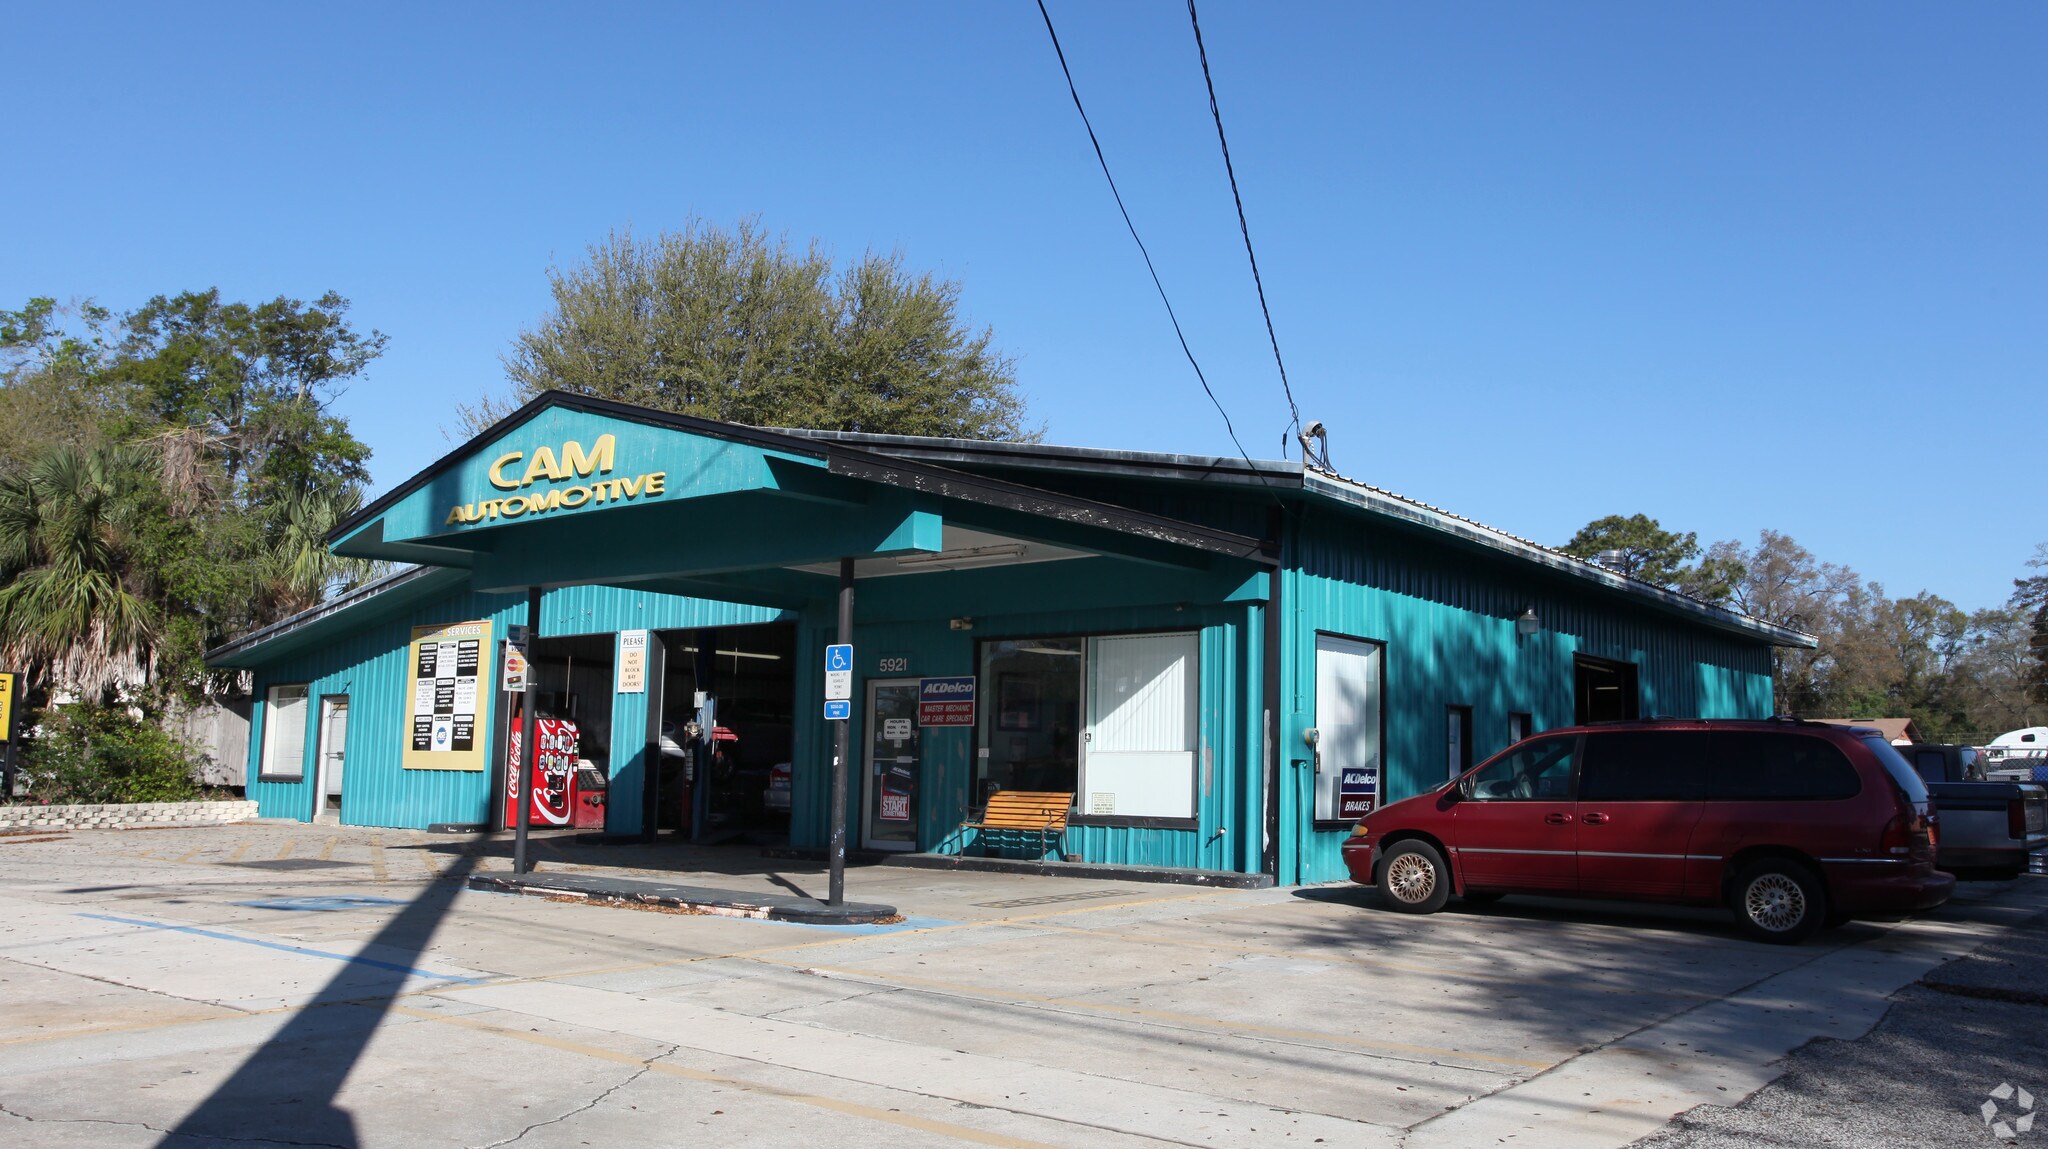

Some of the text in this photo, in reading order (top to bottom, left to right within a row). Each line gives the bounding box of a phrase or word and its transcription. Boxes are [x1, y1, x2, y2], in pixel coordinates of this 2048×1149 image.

[488, 433, 616, 490] CAM
[445, 471, 666, 525] AUTOMOTIVE
[447, 625, 481, 637] SERVICES
[623, 637, 644, 646] PLEASE
[879, 658, 907, 672] 5921
[924, 682, 973, 693] ACDelco
[924, 703, 971, 713] MASTER MECHANIC
[920, 714, 973, 723] CAR CARE SPECIALIST
[1343, 773, 1377, 785] ACDelco
[882, 800, 907, 811] START
[1344, 801, 1370, 811] BRAKES
